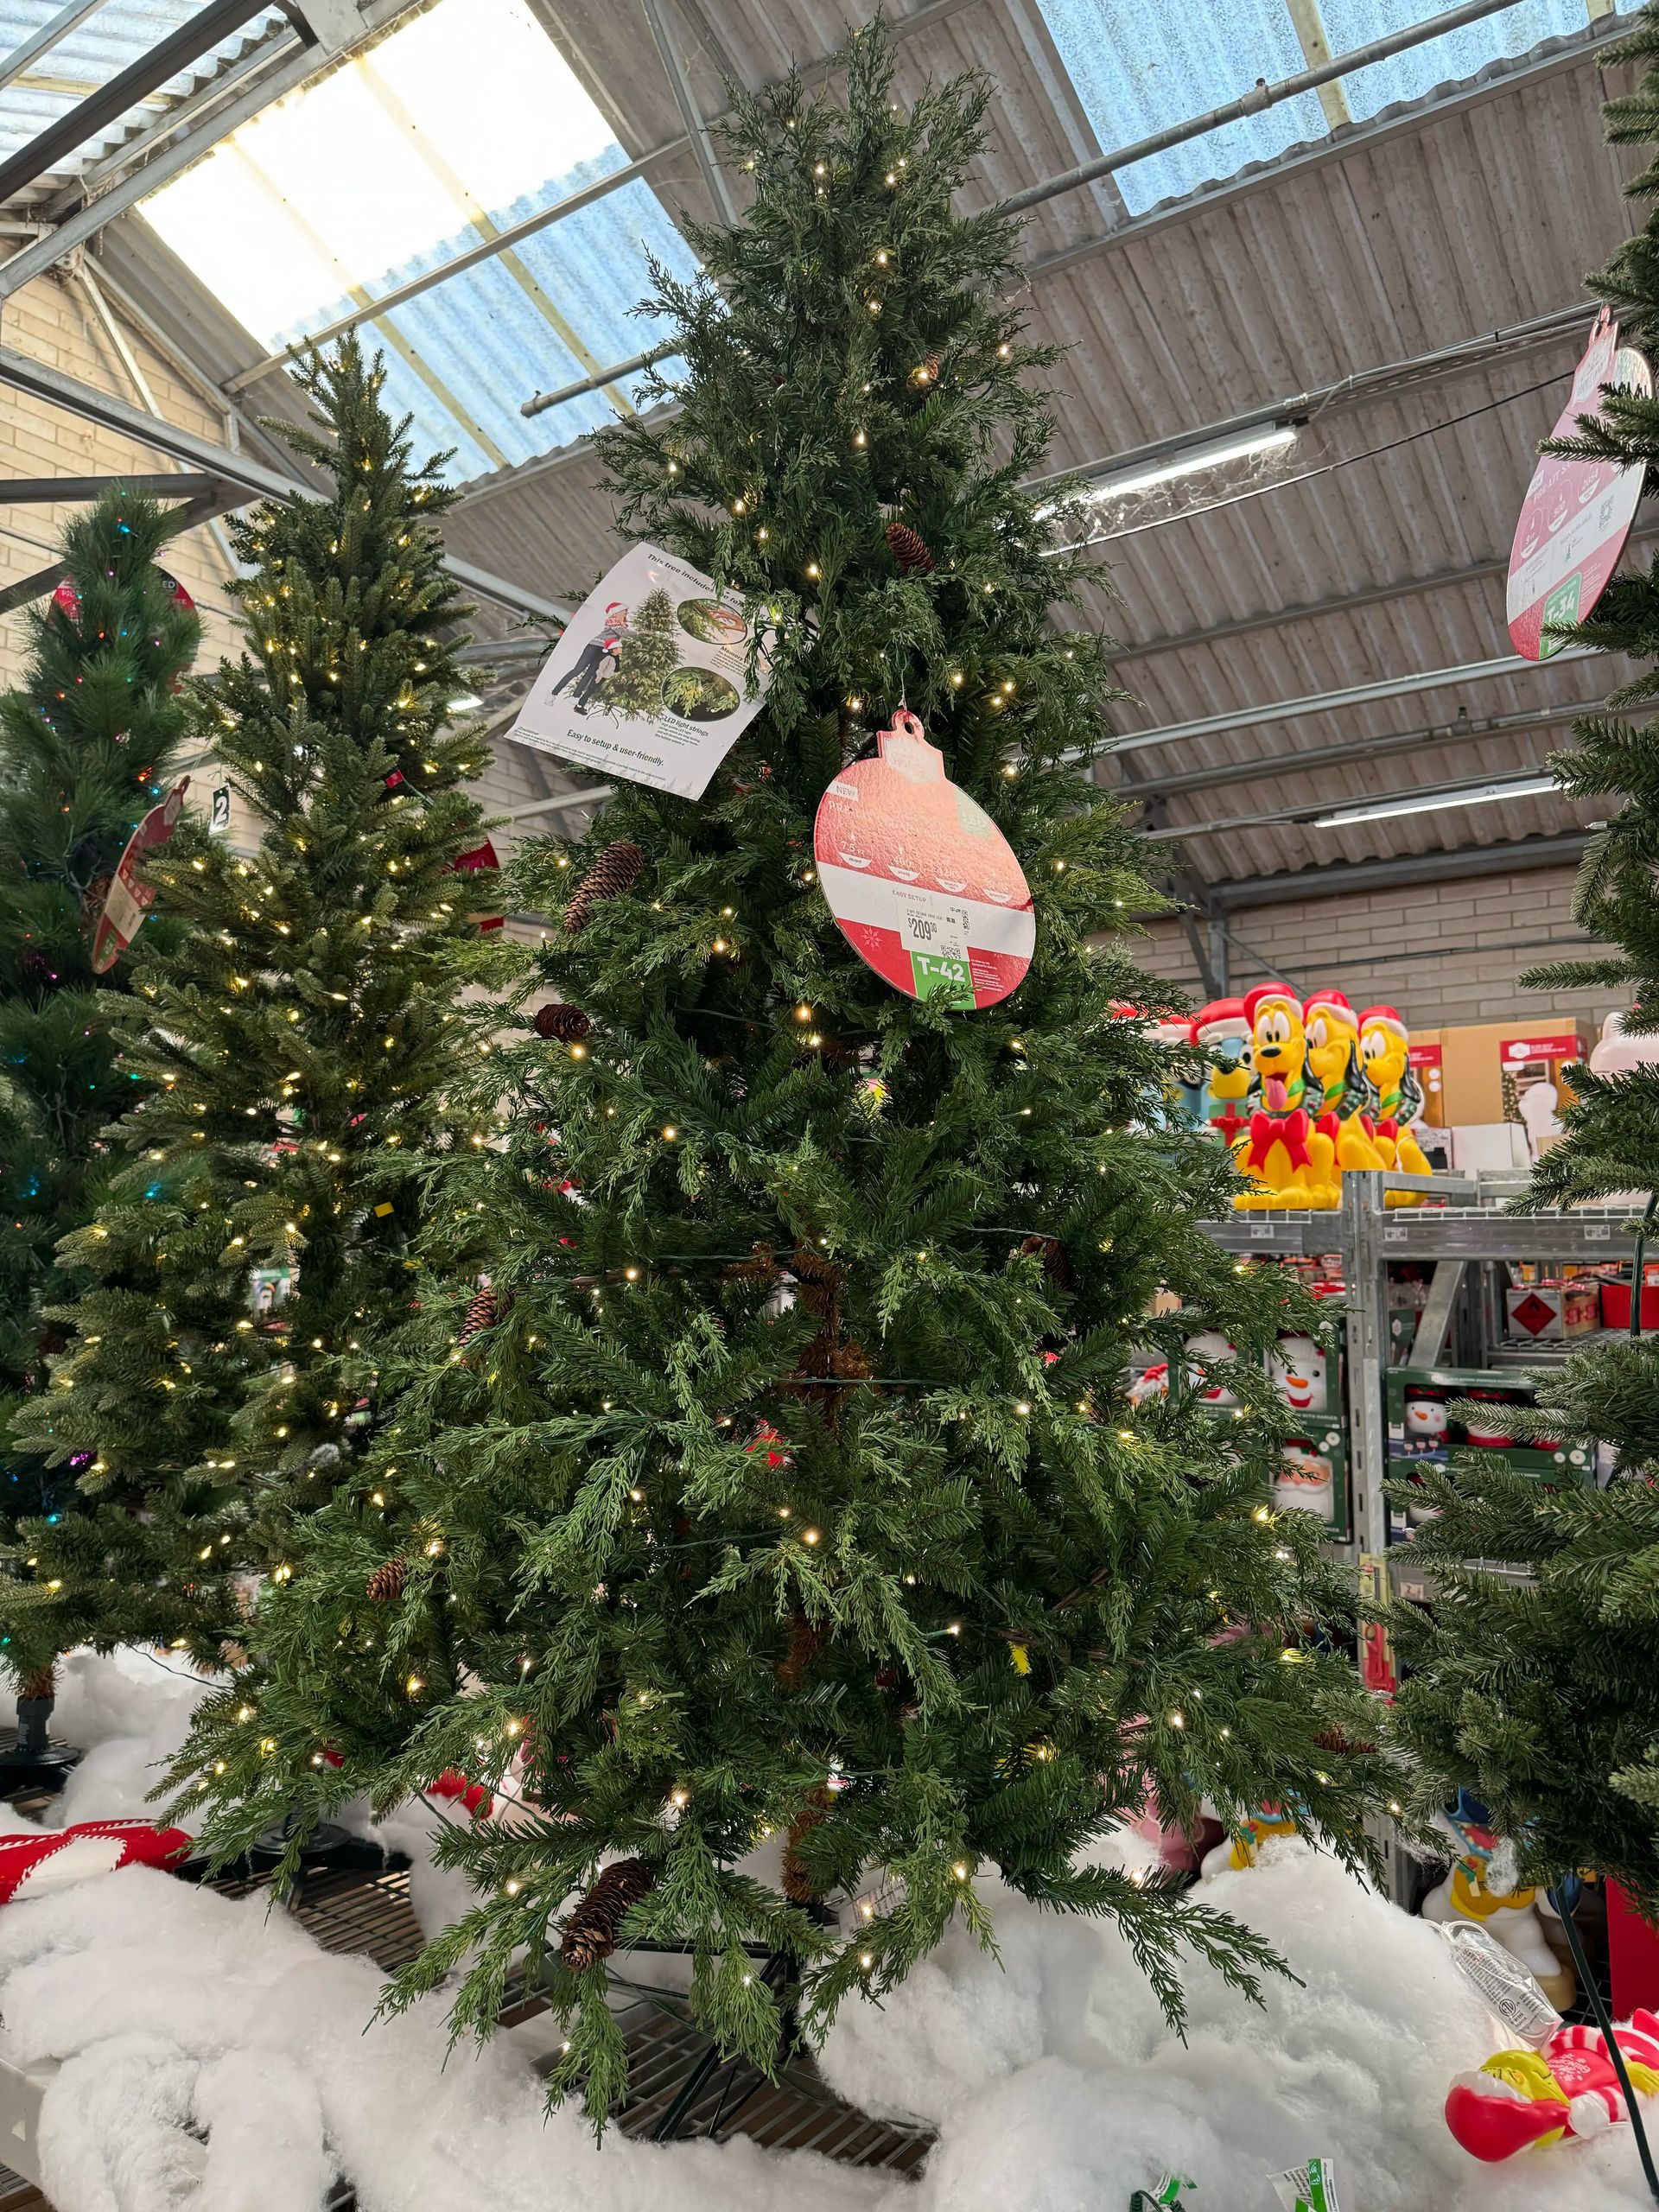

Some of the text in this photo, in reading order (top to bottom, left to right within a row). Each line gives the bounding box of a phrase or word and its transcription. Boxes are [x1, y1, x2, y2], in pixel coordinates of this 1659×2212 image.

[648, 554, 664, 565] This
[664, 562, 681, 574] tree
[721, 645, 743, 661] Memory
[664, 715, 709, 736] LED light strings
[567, 729, 583, 741] Easy
[584, 734, 591, 743] to
[592, 738, 612, 750] setup
[620, 747, 664, 766] user-friendly.
[216, 796, 228, 823] 2
[842, 841, 855, 852] 7.5
[892, 889, 927, 902] EASY SETUP
[917, 956, 966, 982] T-42
